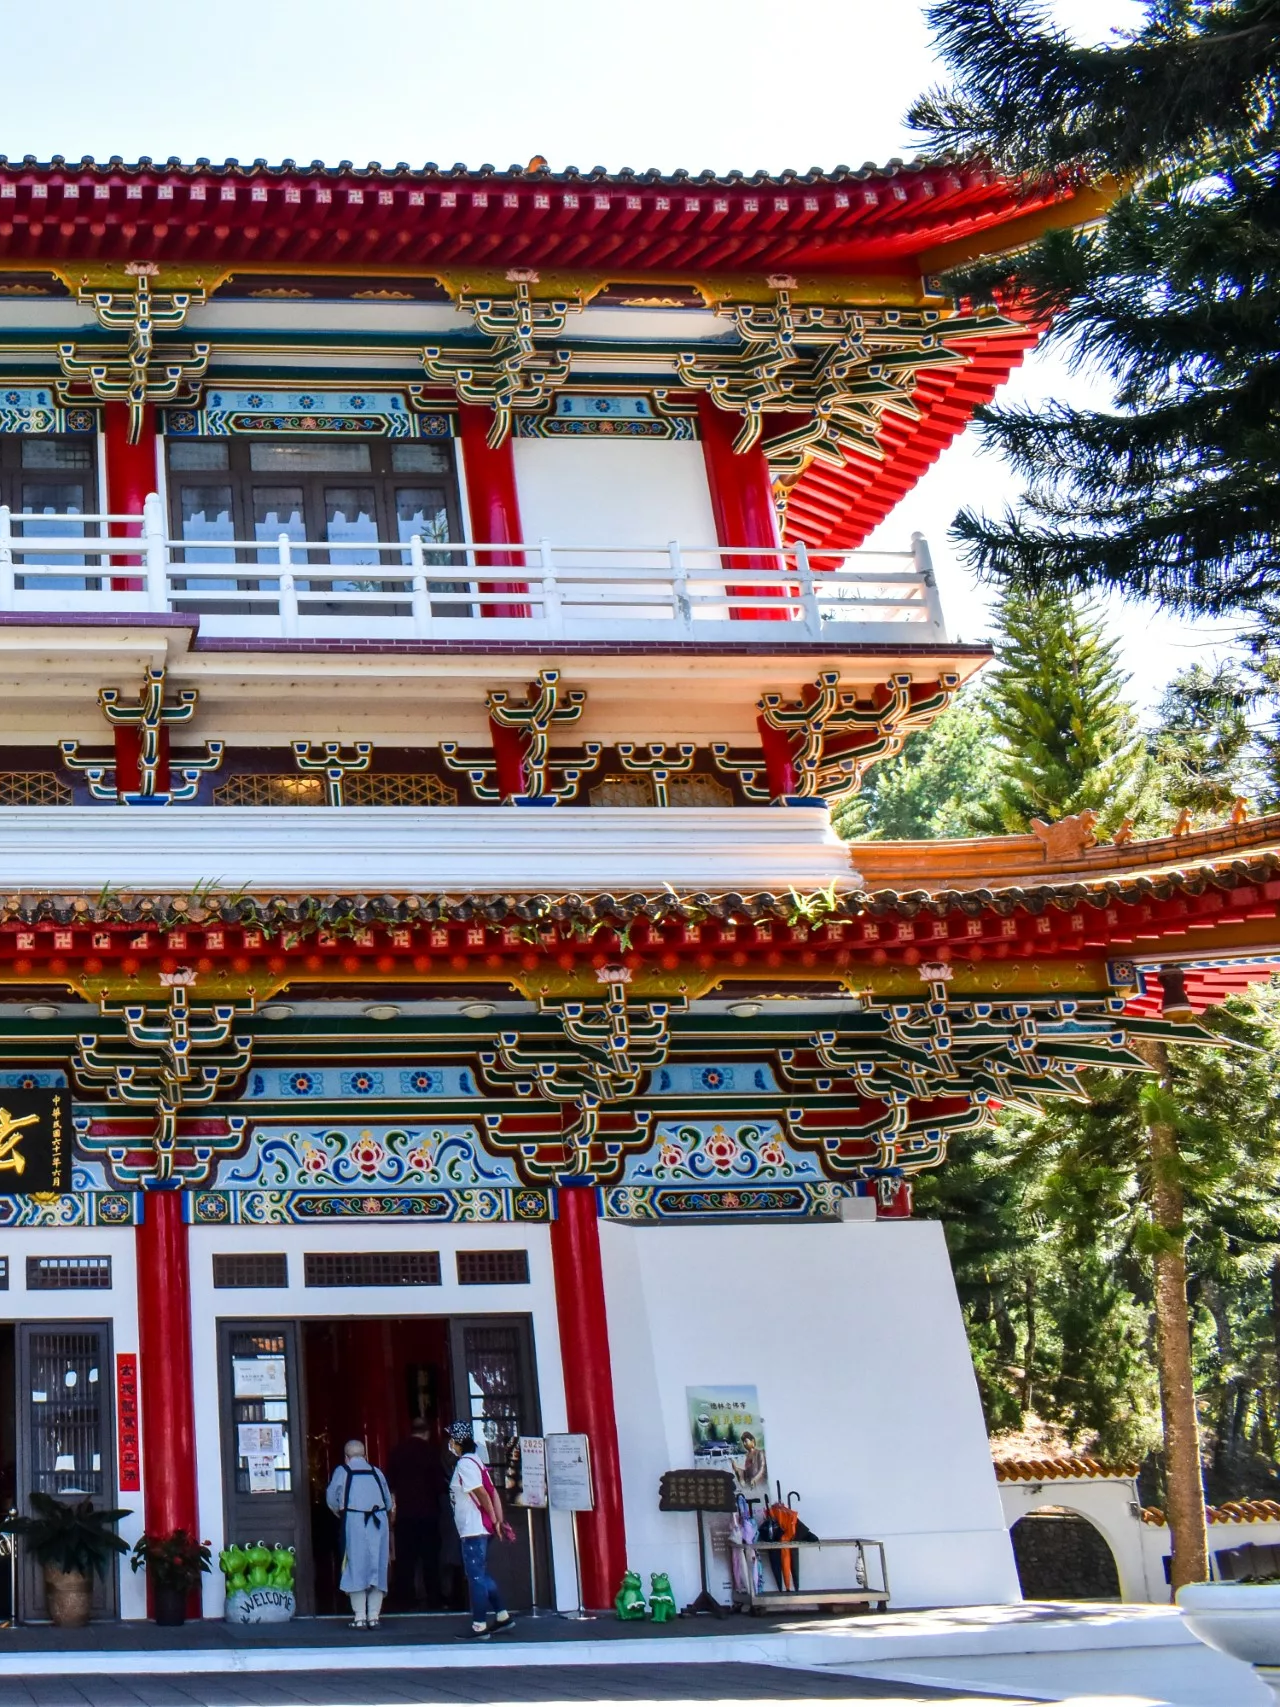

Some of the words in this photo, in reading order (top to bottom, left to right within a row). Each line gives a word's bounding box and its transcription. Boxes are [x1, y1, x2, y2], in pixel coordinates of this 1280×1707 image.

[51, 1094, 62, 1187] 中華民國六十一年六月
[523, 1439, 543, 1449] 2025
[239, 1591, 293, 1614] WELCOME
